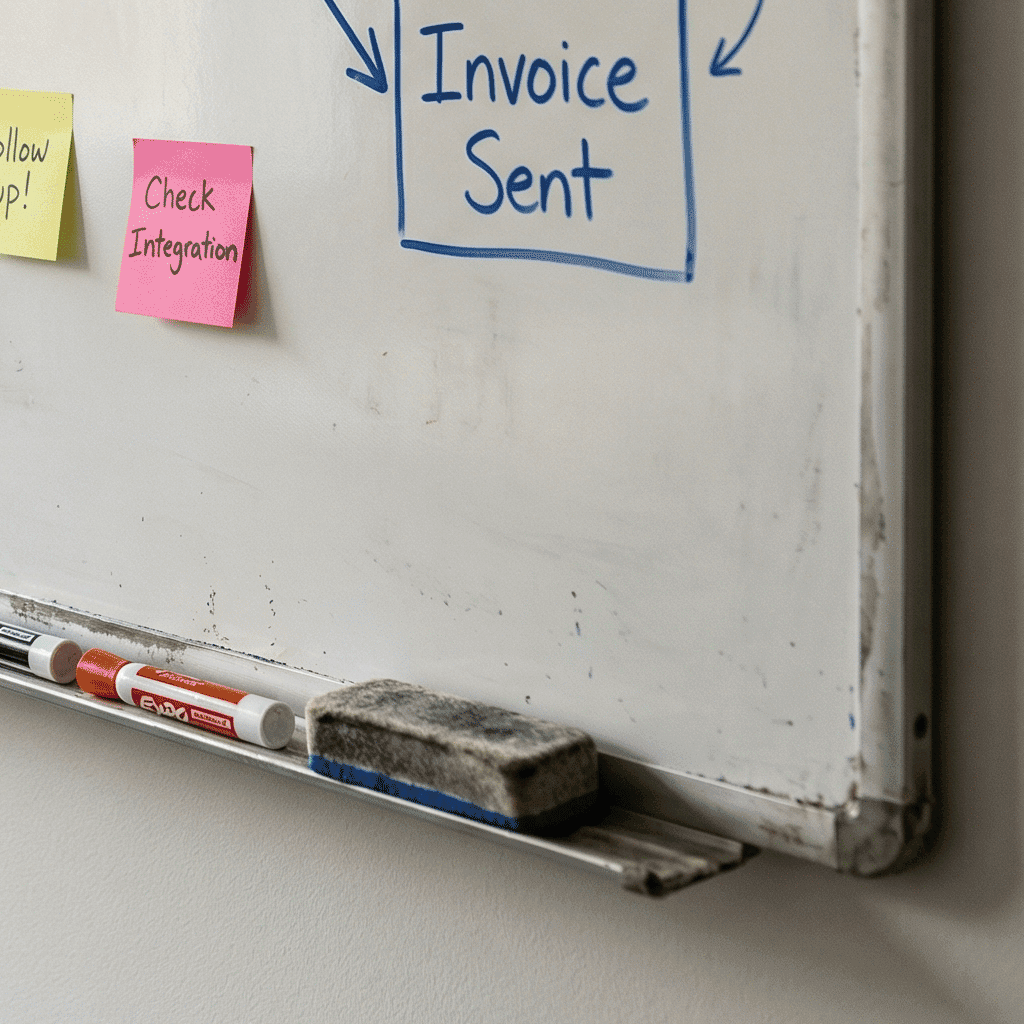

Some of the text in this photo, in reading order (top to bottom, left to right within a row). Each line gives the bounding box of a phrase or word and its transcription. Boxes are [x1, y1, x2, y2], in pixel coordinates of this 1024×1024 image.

[419, 22, 650, 113] Invoice
[144, 174, 216, 212] Check
[464, 128, 614, 221] Sent
[128, 227, 238, 276] Integration
